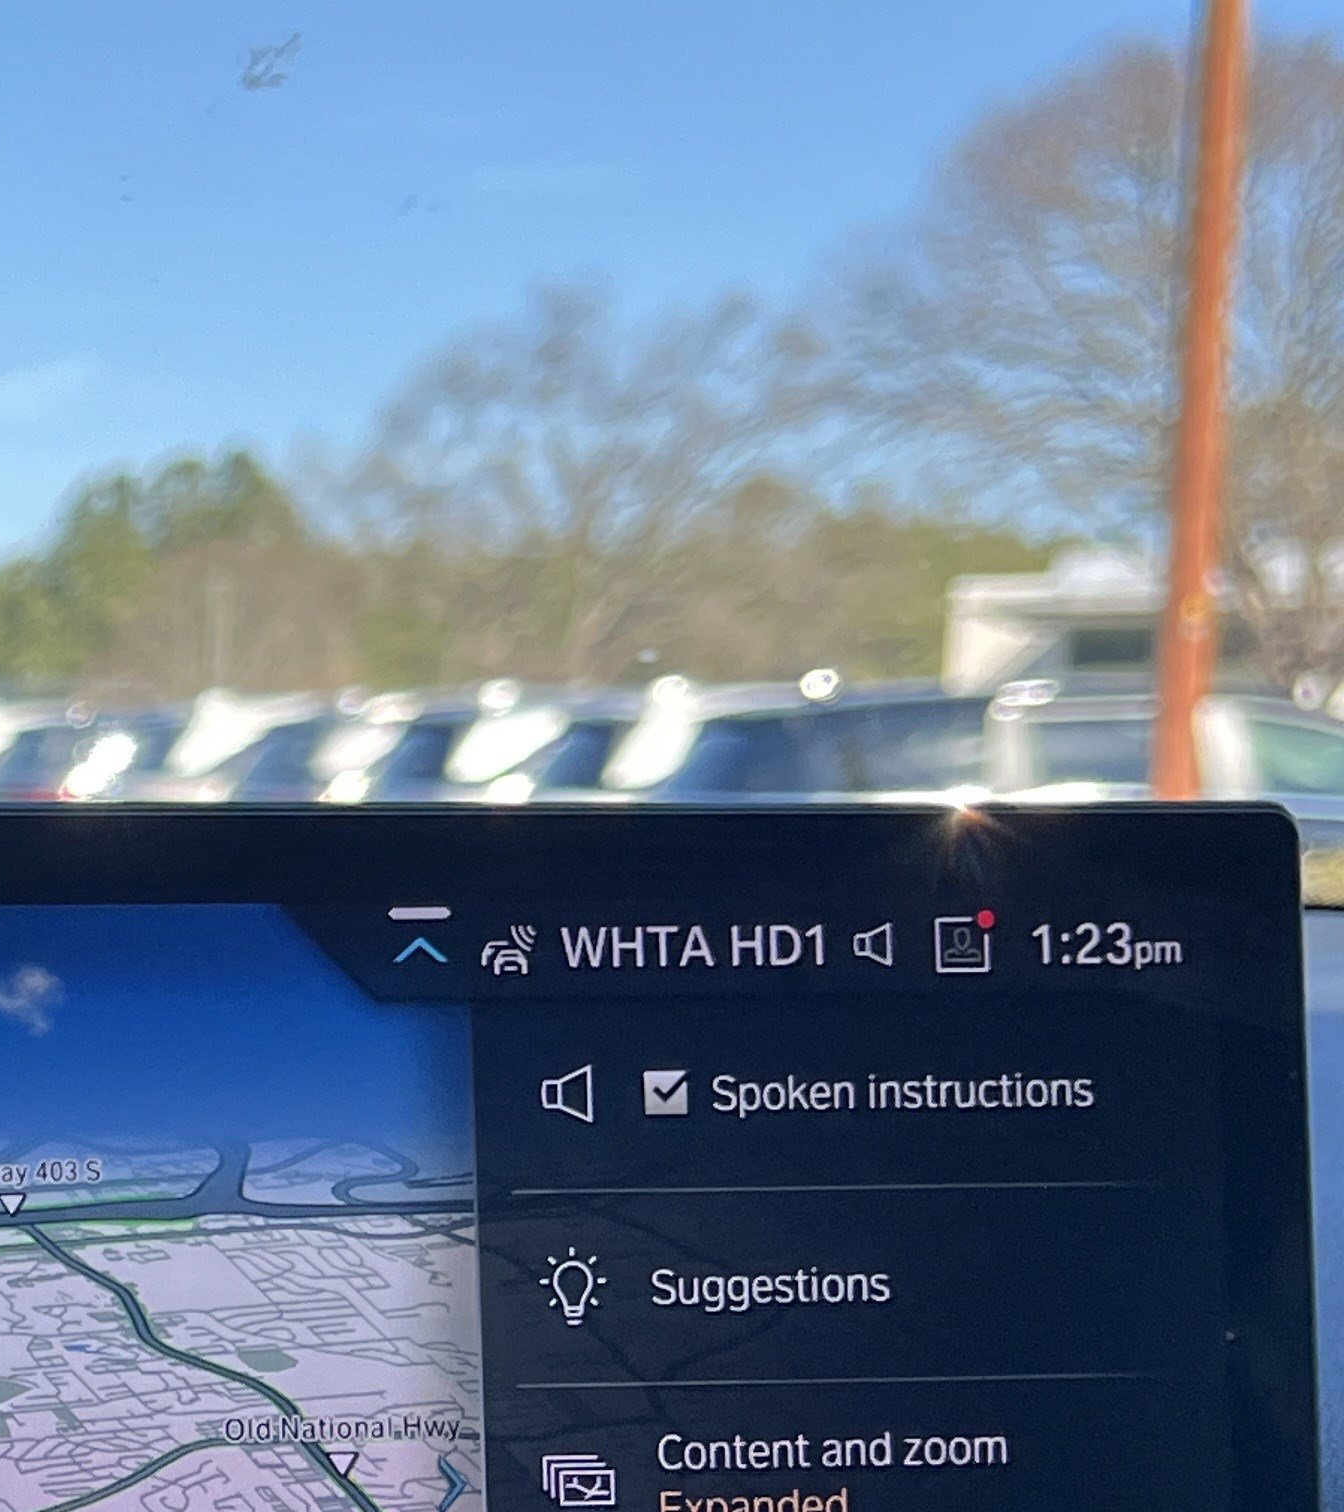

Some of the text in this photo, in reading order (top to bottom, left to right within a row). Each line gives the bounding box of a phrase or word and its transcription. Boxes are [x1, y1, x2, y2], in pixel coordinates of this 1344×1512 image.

[561, 925, 823, 967] WHTA HD1
[1033, 923, 1182, 969] 1:23pm
[713, 1073, 1093, 1118] Spoken instructions
[34, 1160, 77, 1181] 403
[84, 1160, 102, 1182] S
[652, 1267, 890, 1312] Suggestions
[225, 1415, 461, 1441] Old National Hwy
[658, 1432, 1007, 1469] Content and zoom
